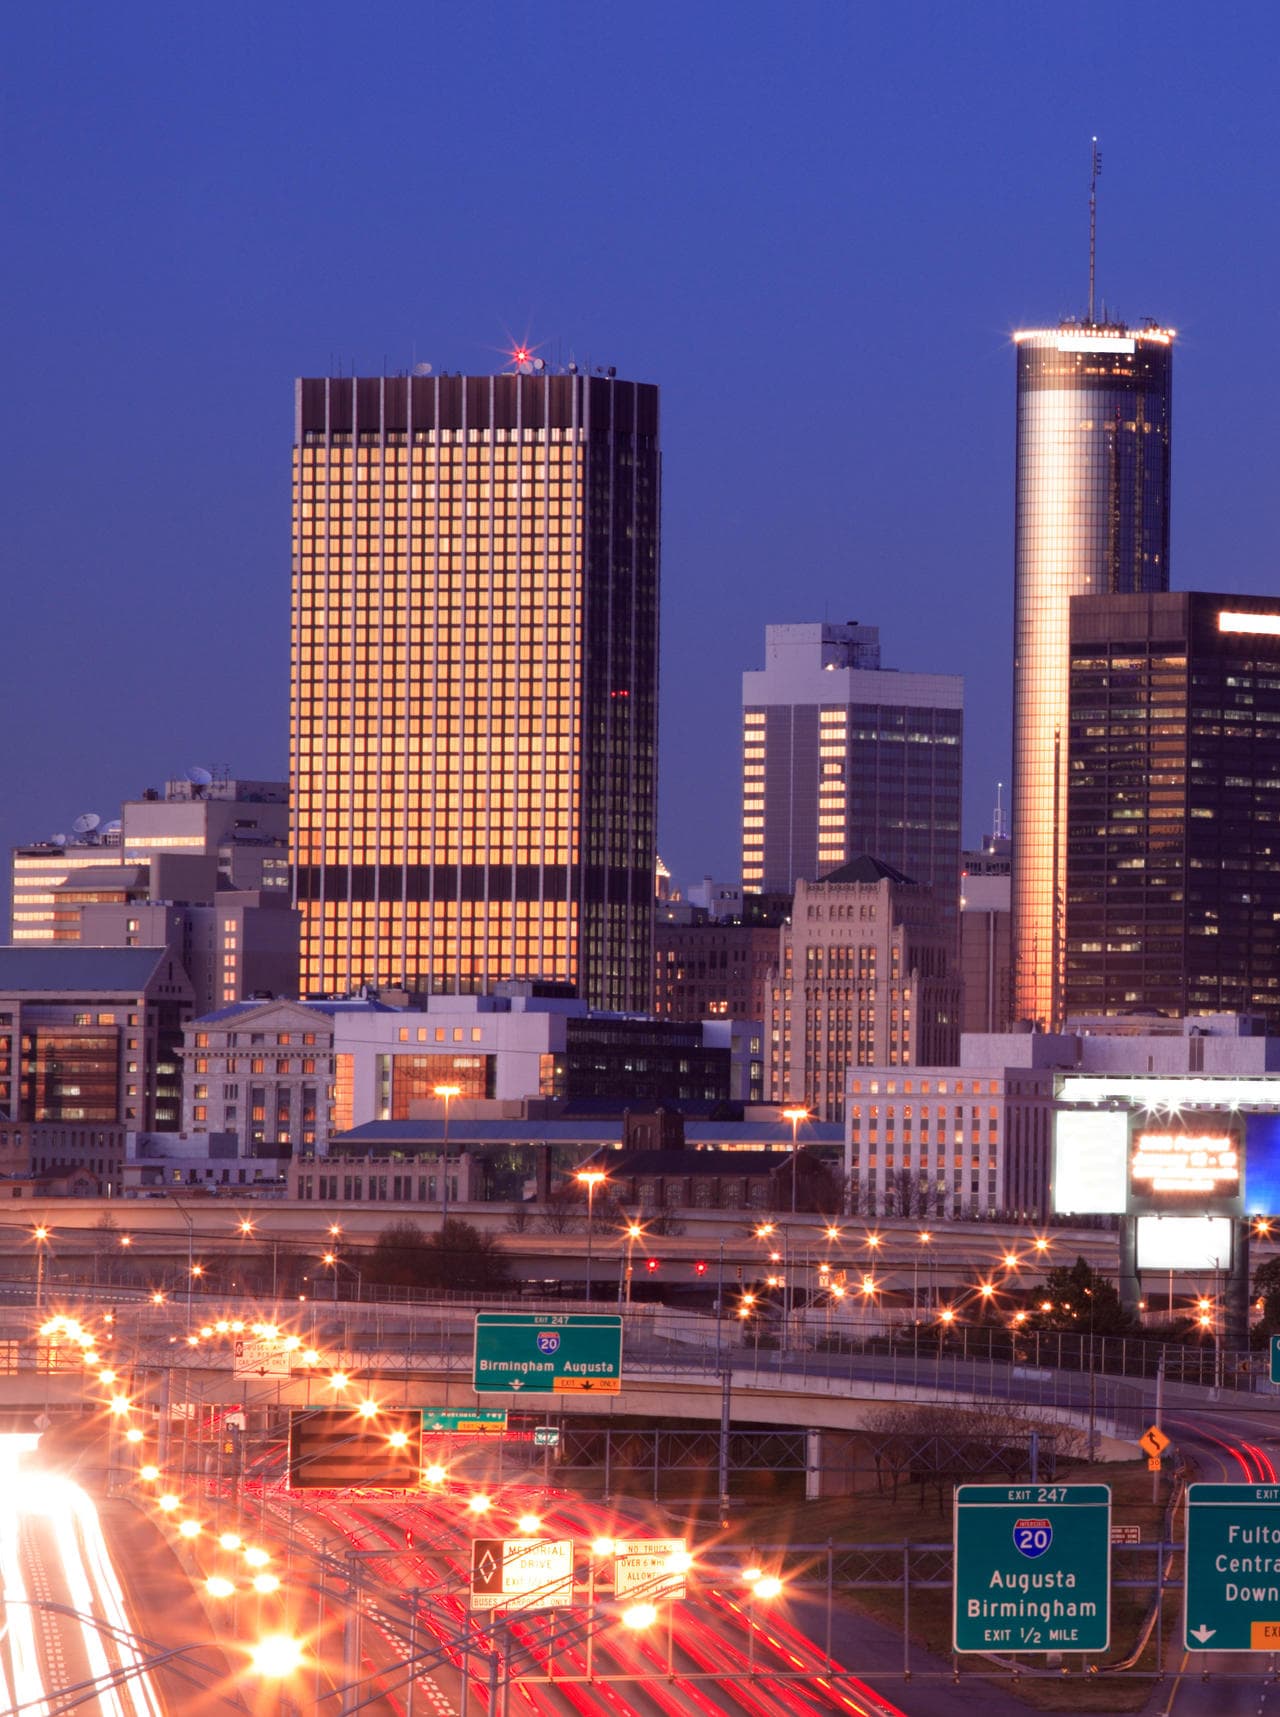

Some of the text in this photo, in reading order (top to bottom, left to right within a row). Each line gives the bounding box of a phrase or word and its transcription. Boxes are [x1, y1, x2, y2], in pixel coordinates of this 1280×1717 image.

[551, 1316, 570, 1325] 247
[541, 1338, 557, 1350] 20
[480, 1360, 614, 1375] Birmingham Augusta
[600, 1380, 617, 1388] ONLY
[1008, 1488, 1068, 1502] EXIT 247
[1256, 1489, 1279, 1499] EXIT
[1020, 1530, 1047, 1549] 20
[508, 1545, 565, 1556] MERIAL
[628, 1545, 639, 1553] NO
[520, 1559, 552, 1569] DRIVE
[621, 1558, 641, 1567] OVER
[627, 1572, 662, 1580] ALLOWE
[989, 1570, 1076, 1594] Augusta
[967, 1599, 1097, 1623] Birmingham
[984, 1629, 1011, 1641] EXIT
[1049, 1629, 1079, 1641] MILE
